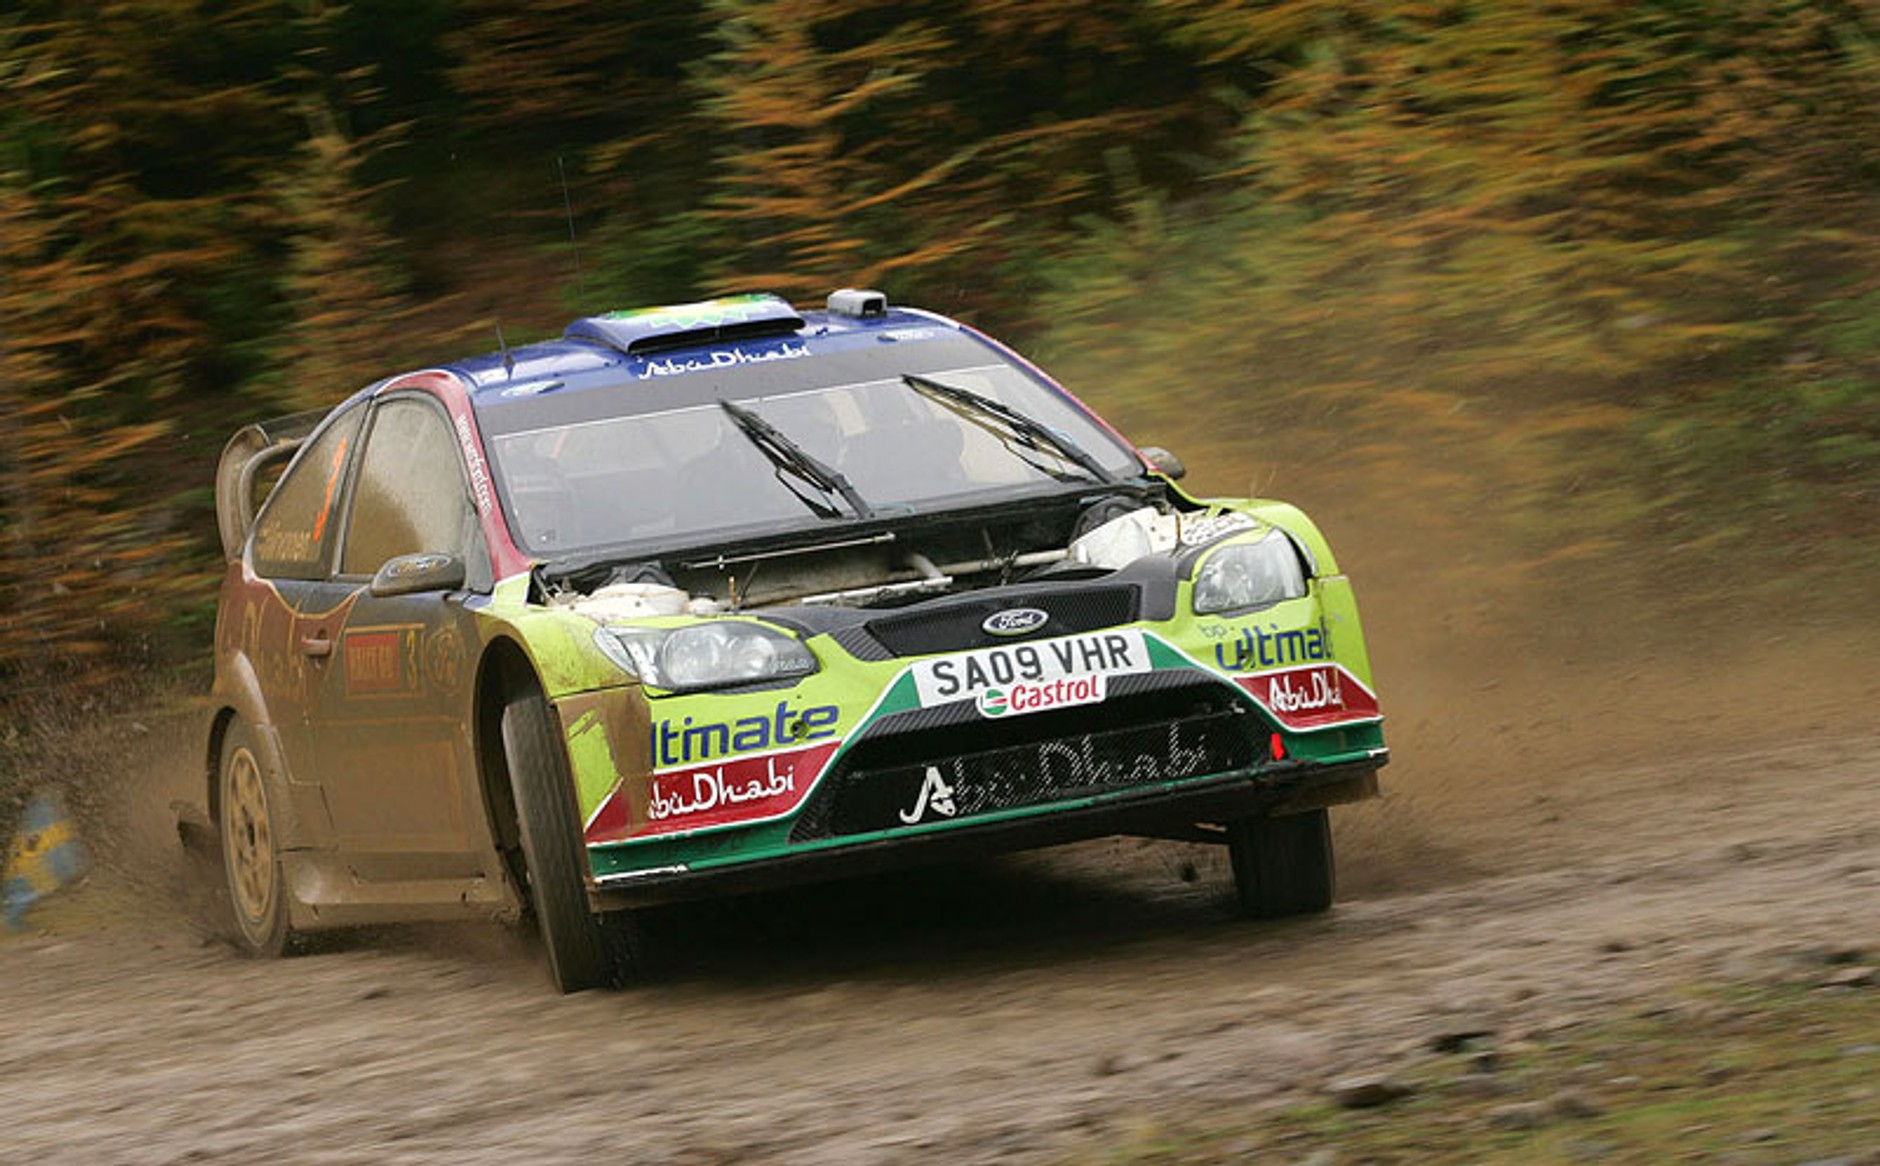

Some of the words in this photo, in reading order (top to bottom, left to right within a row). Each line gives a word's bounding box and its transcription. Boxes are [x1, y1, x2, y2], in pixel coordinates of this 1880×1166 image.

[931, 645, 1044, 697] SA09
[1049, 634, 1132, 674] VHR
[1010, 674, 1099, 710] Castrol
[651, 700, 839, 768] ltimate
[688, 757, 795, 811] Dhabi
